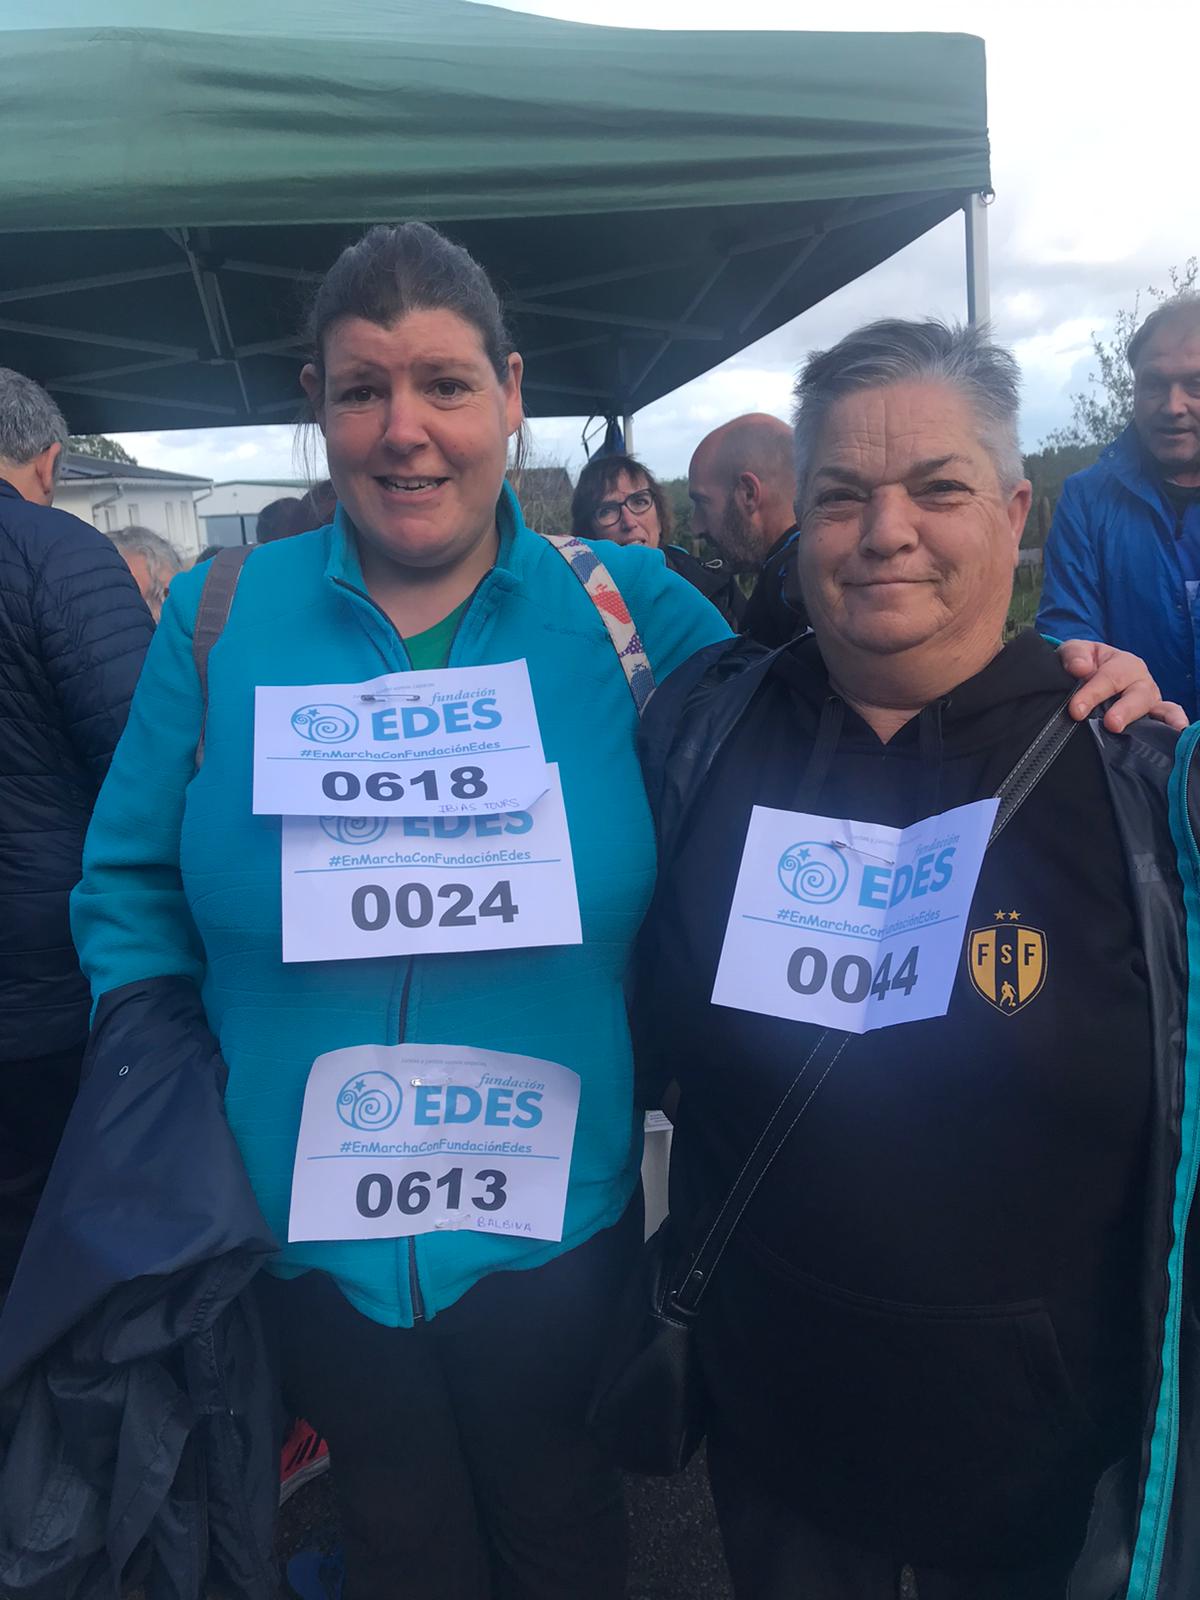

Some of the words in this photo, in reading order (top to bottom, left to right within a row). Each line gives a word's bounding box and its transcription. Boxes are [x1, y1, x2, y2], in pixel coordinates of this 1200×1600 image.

[431, 687, 496, 706] fundación
[371, 698, 502, 742] EDES
[300, 740, 501, 760] #EnMarchaConFundaciónEdes
[321, 765, 489, 802] 0618
[402, 810, 534, 839] EDES
[328, 849, 532, 868] #EnMarchaConFundaciónEdes
[857, 846, 957, 910] EDES
[351, 880, 519, 932] 0024
[786, 945, 920, 1004] 0044
[478, 1072, 545, 1091] fundación
[413, 1084, 544, 1129] EDES
[339, 1138, 532, 1154] #EnMarchaConFundaciónEdes
[355, 1167, 508, 1219] 0613
